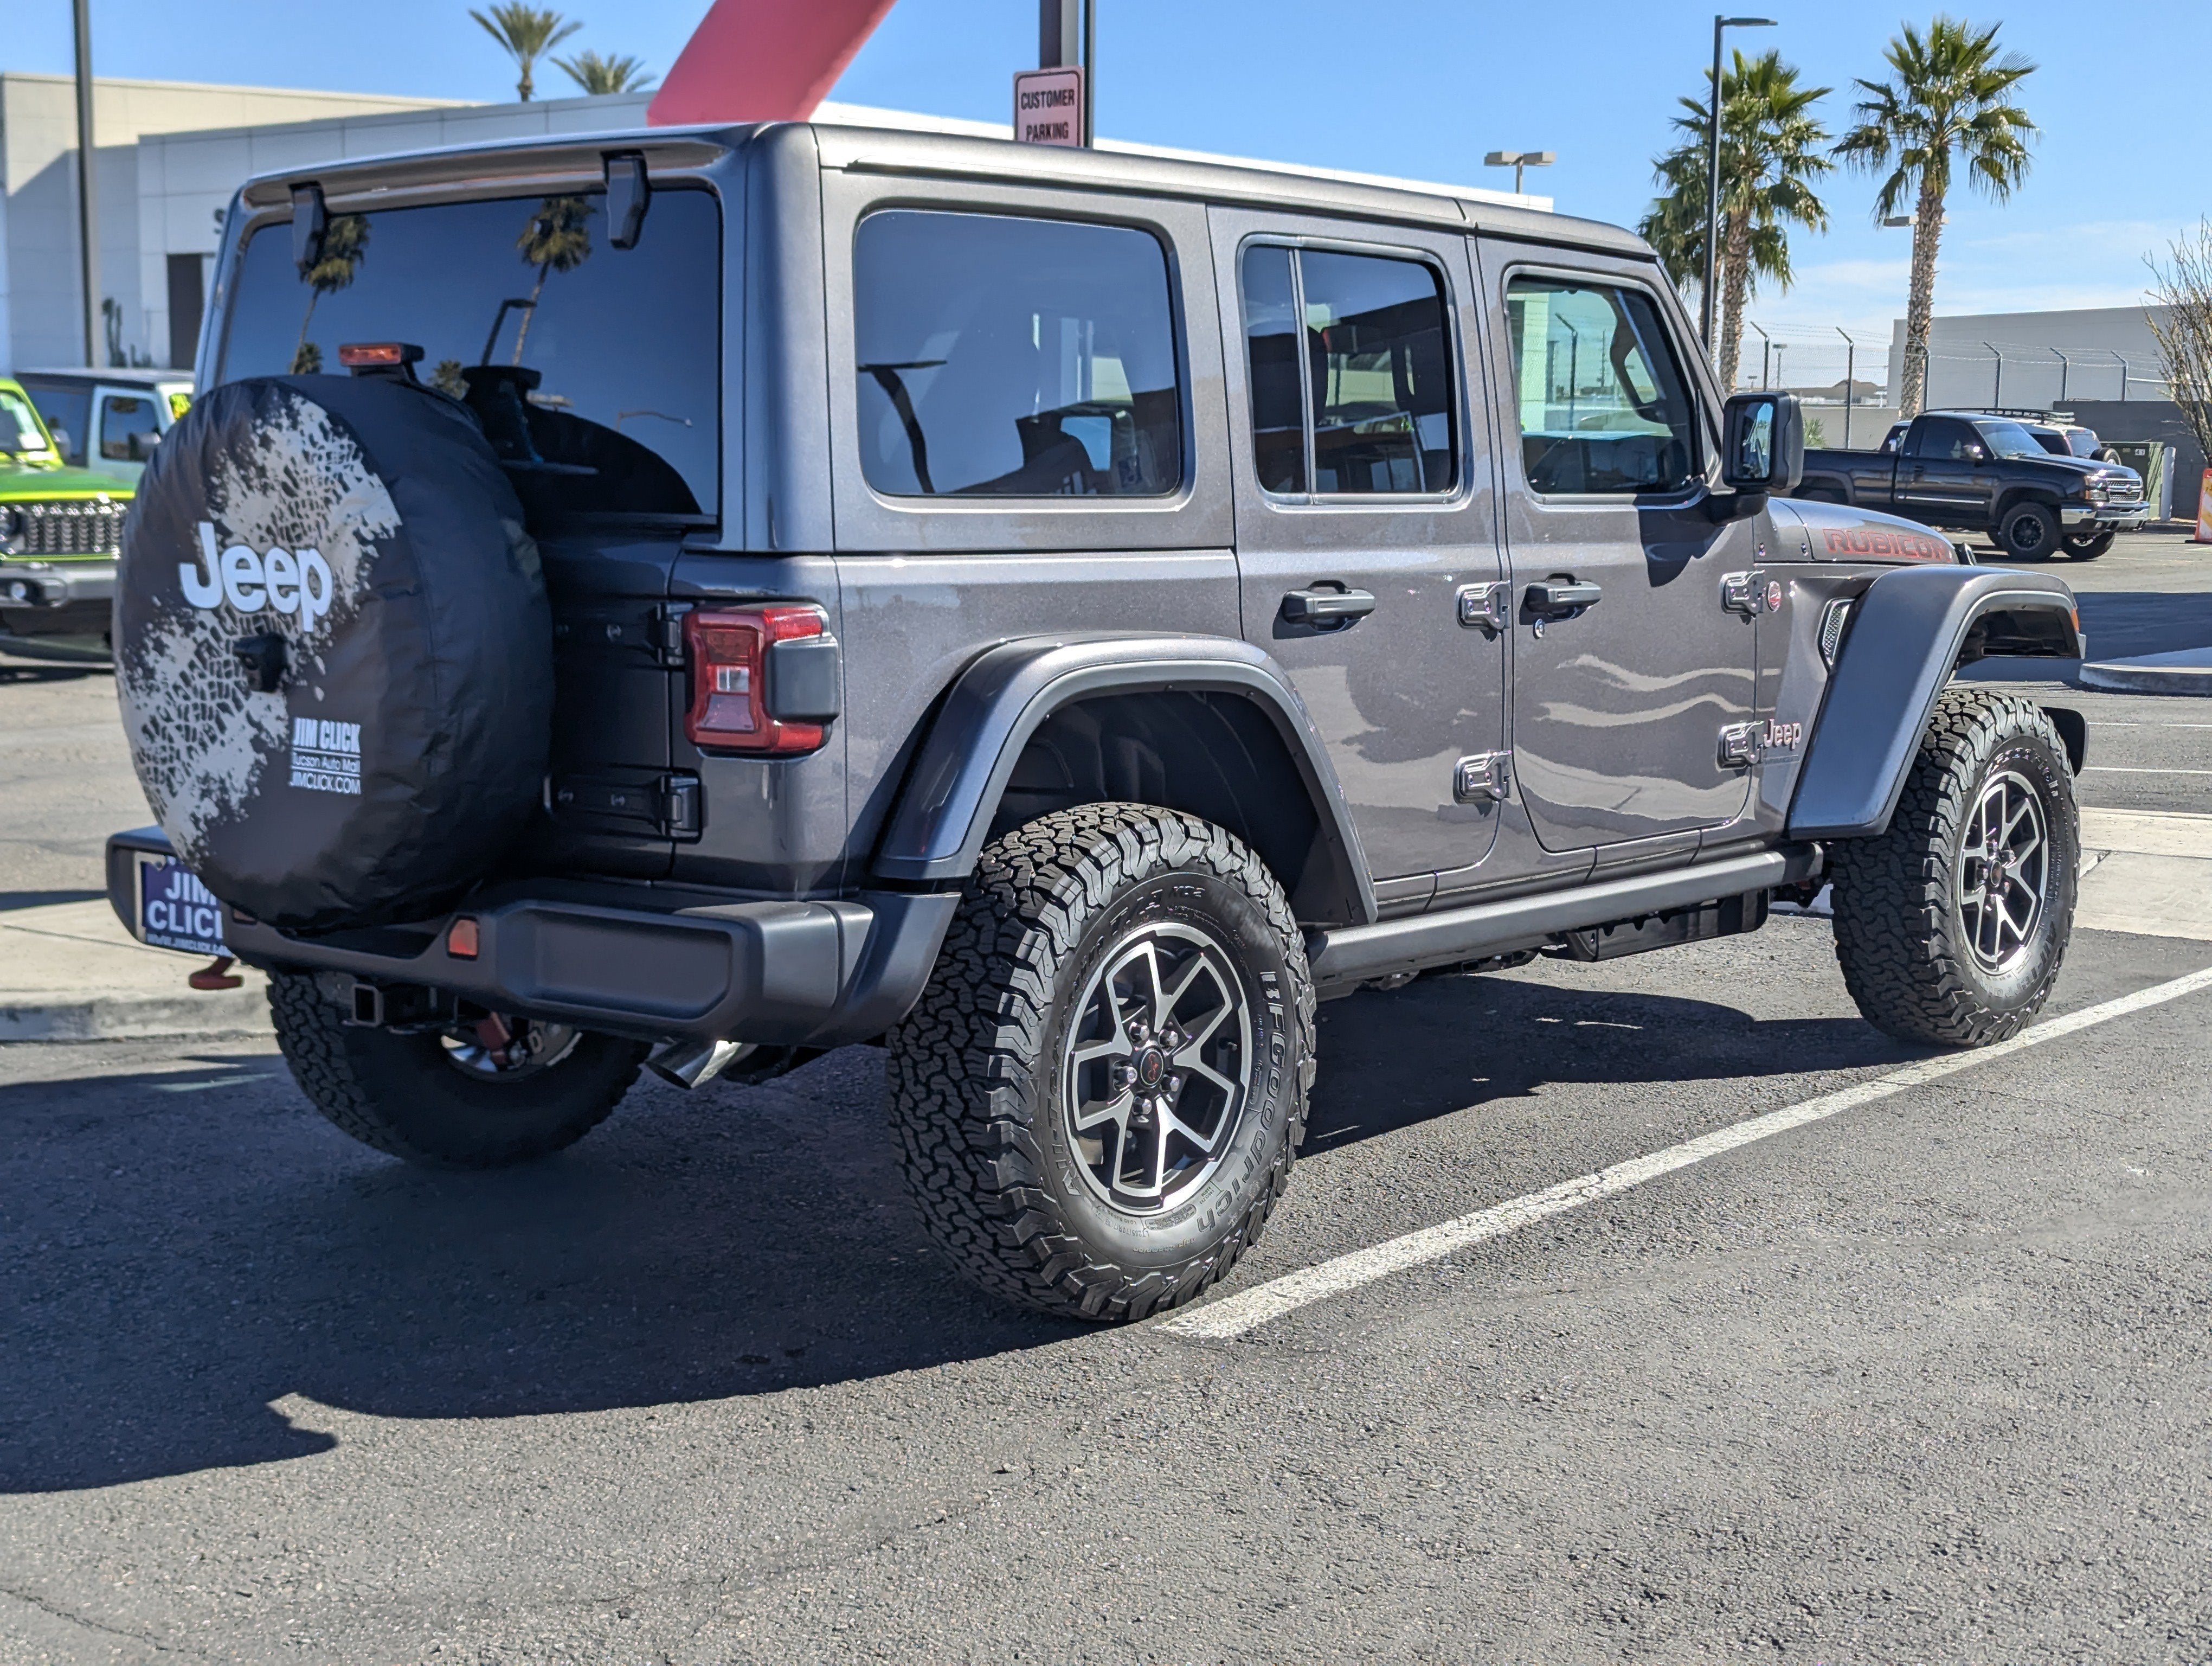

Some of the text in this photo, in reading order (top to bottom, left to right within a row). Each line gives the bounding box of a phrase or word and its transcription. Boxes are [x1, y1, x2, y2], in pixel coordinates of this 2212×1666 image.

[1020, 89, 1075, 110] CUSTOMER
[1026, 121, 1069, 142] PARKING
[1822, 528, 1952, 563] RUBICON
[179, 521, 332, 632] Jeep
[293, 717, 361, 753] JIM CLICK
[1763, 718, 1802, 751] Jeep
